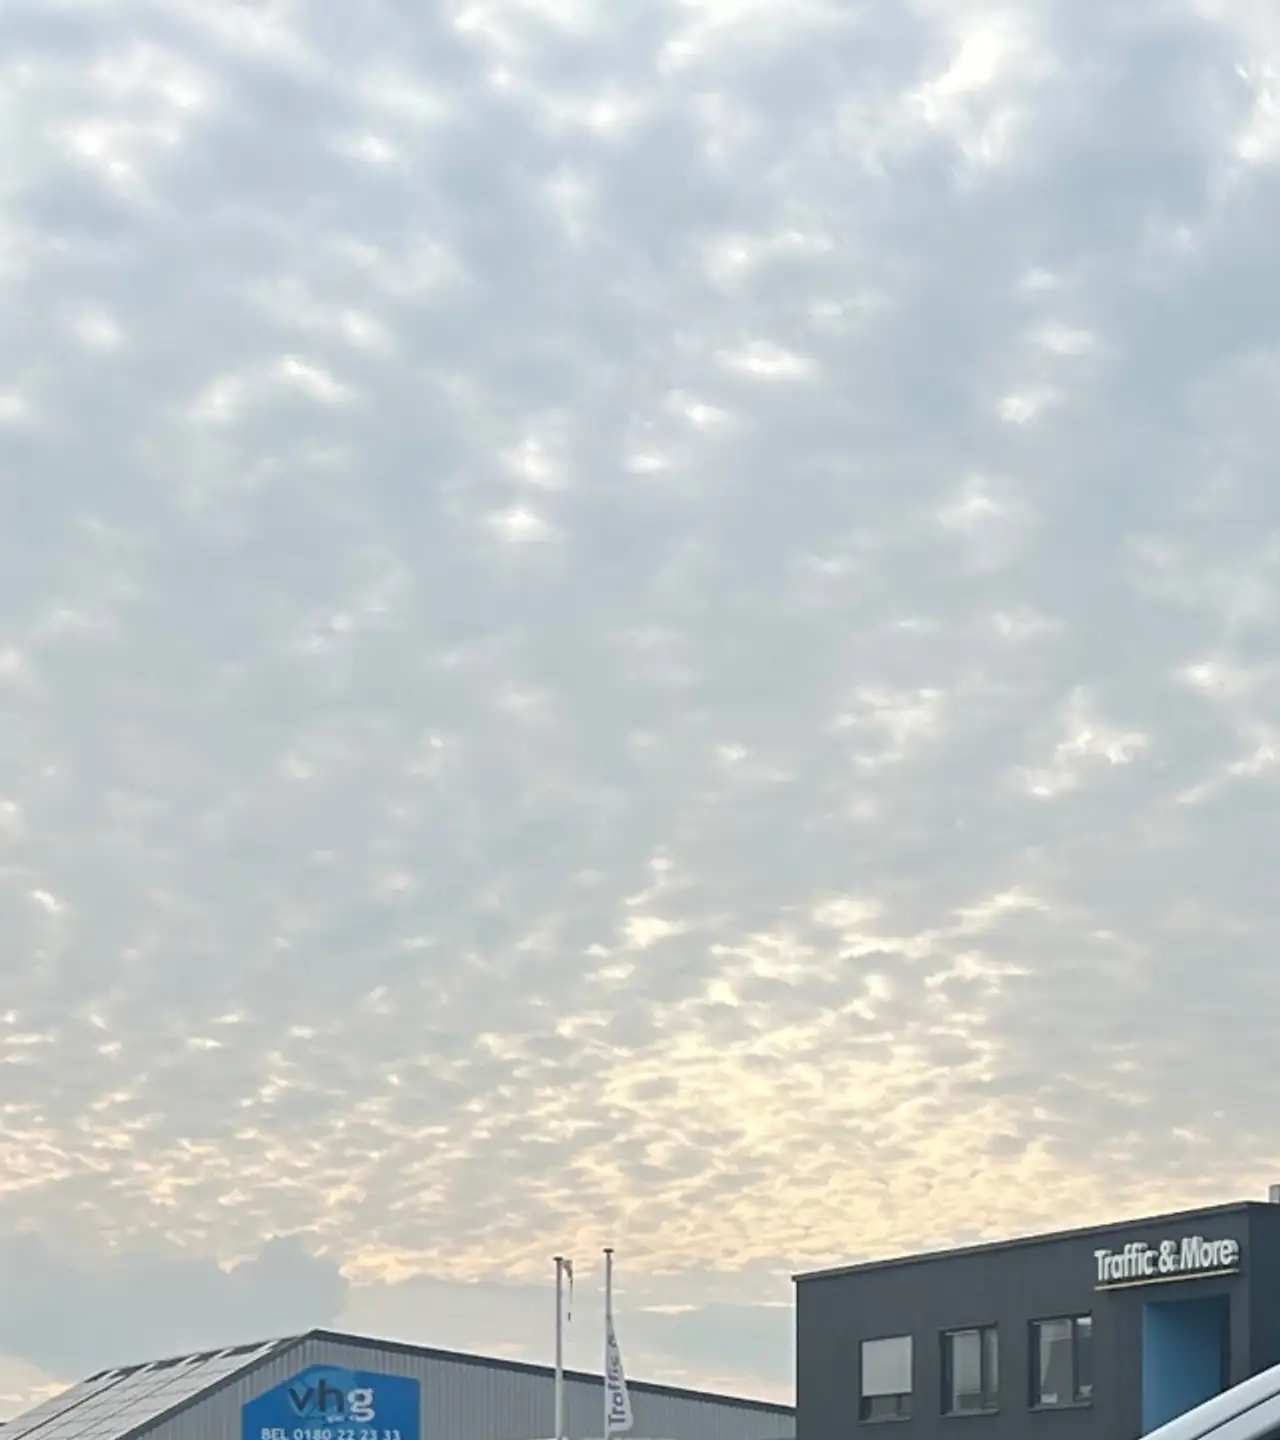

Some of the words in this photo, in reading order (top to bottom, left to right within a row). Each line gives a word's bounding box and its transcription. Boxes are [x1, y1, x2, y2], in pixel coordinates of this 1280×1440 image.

[1094, 1241, 1158, 1282] Traffic
[1158, 1239, 1179, 1273] &
[1180, 1235, 1240, 1270] More
[288, 1379, 376, 1423] vhg
